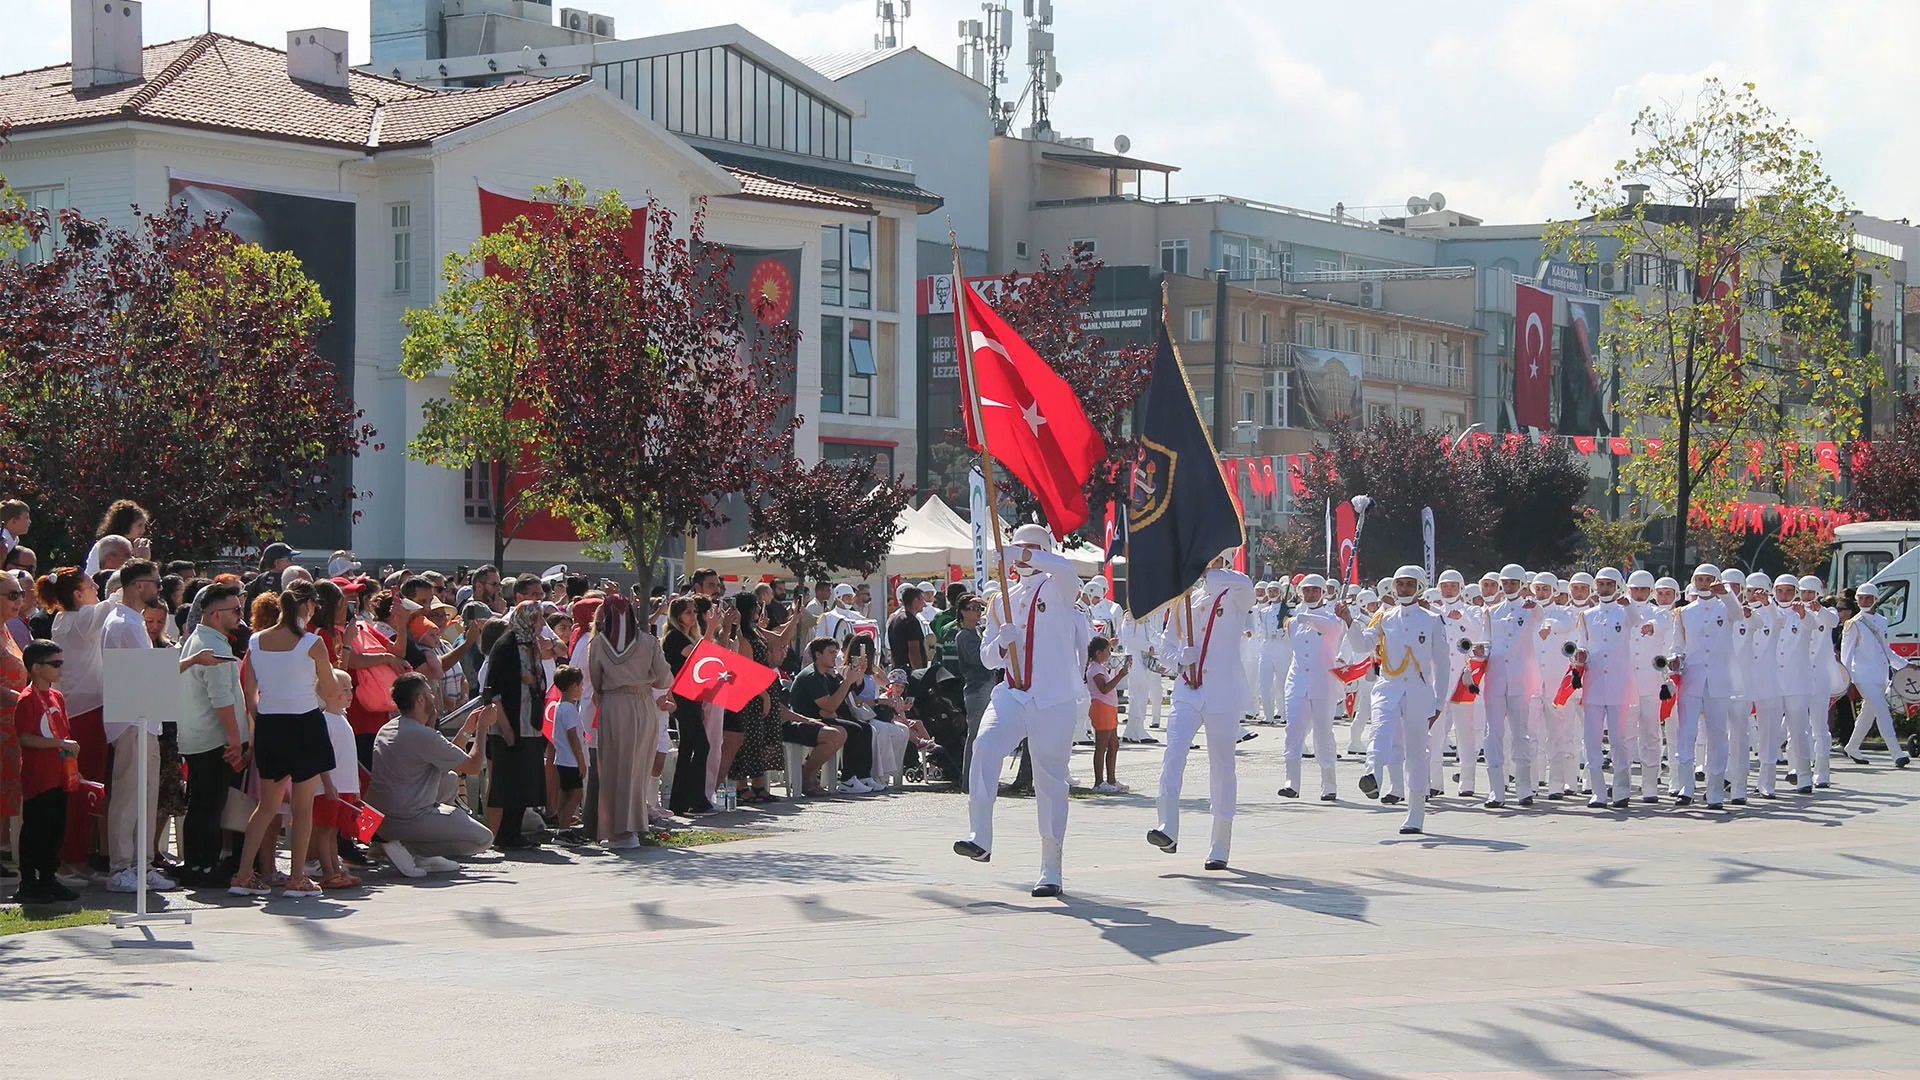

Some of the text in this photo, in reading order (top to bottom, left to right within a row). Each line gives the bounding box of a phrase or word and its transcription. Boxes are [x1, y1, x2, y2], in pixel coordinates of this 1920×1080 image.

[1102, 309, 1126, 318] YERKEN
[1127, 308, 1148, 317] MUTLU
[932, 336, 950, 349] HER
[932, 351, 951, 363] HEP
